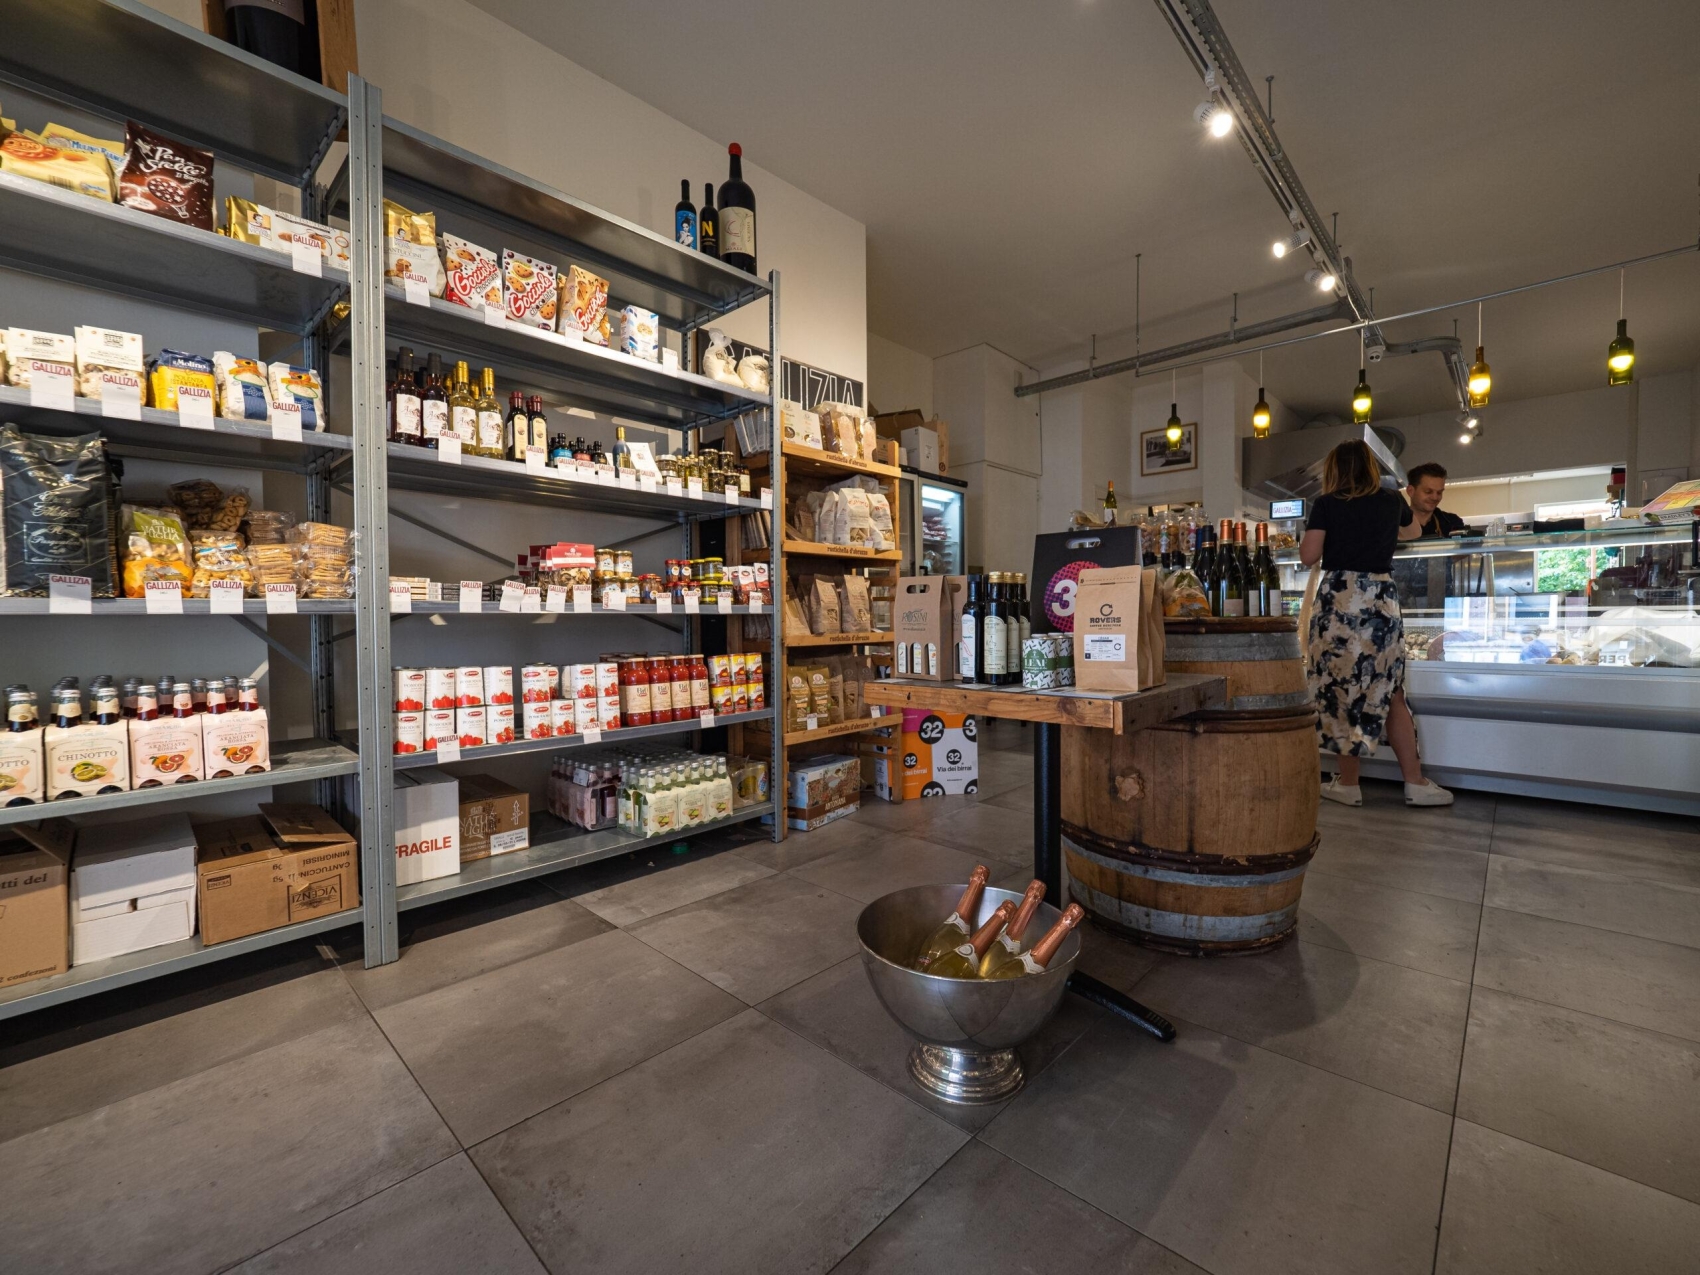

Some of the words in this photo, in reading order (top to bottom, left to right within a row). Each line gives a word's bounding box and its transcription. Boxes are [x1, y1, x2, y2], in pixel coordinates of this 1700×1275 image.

[702, 220, 713, 237] N
[293, 234, 320, 248] GALLIZIA
[32, 361, 73, 378] GALLIZIA
[103, 373, 139, 388] GALLIZIA
[179, 386, 211, 399] GALLIZIA
[272, 401, 300, 413] GALLIZIA
[51, 575, 91, 585] GALLIZIA
[146, 581, 180, 590] GALLIZIA
[212, 580, 243, 590] GALLIZIA
[461, 581, 482, 589] GALLIZIA
[266, 584, 296, 593] GALLIZIA
[524, 587, 540, 595] ALLIZIA
[920, 721, 943, 739] 32
[58, 750, 118, 762] CHINOTTO
[904, 755, 917, 766] 32
[948, 752, 961, 763] 32
[23, 873, 48, 885] del
[291, 885, 338, 904] VICENZI
[7, 965, 57, 982] confezioni
